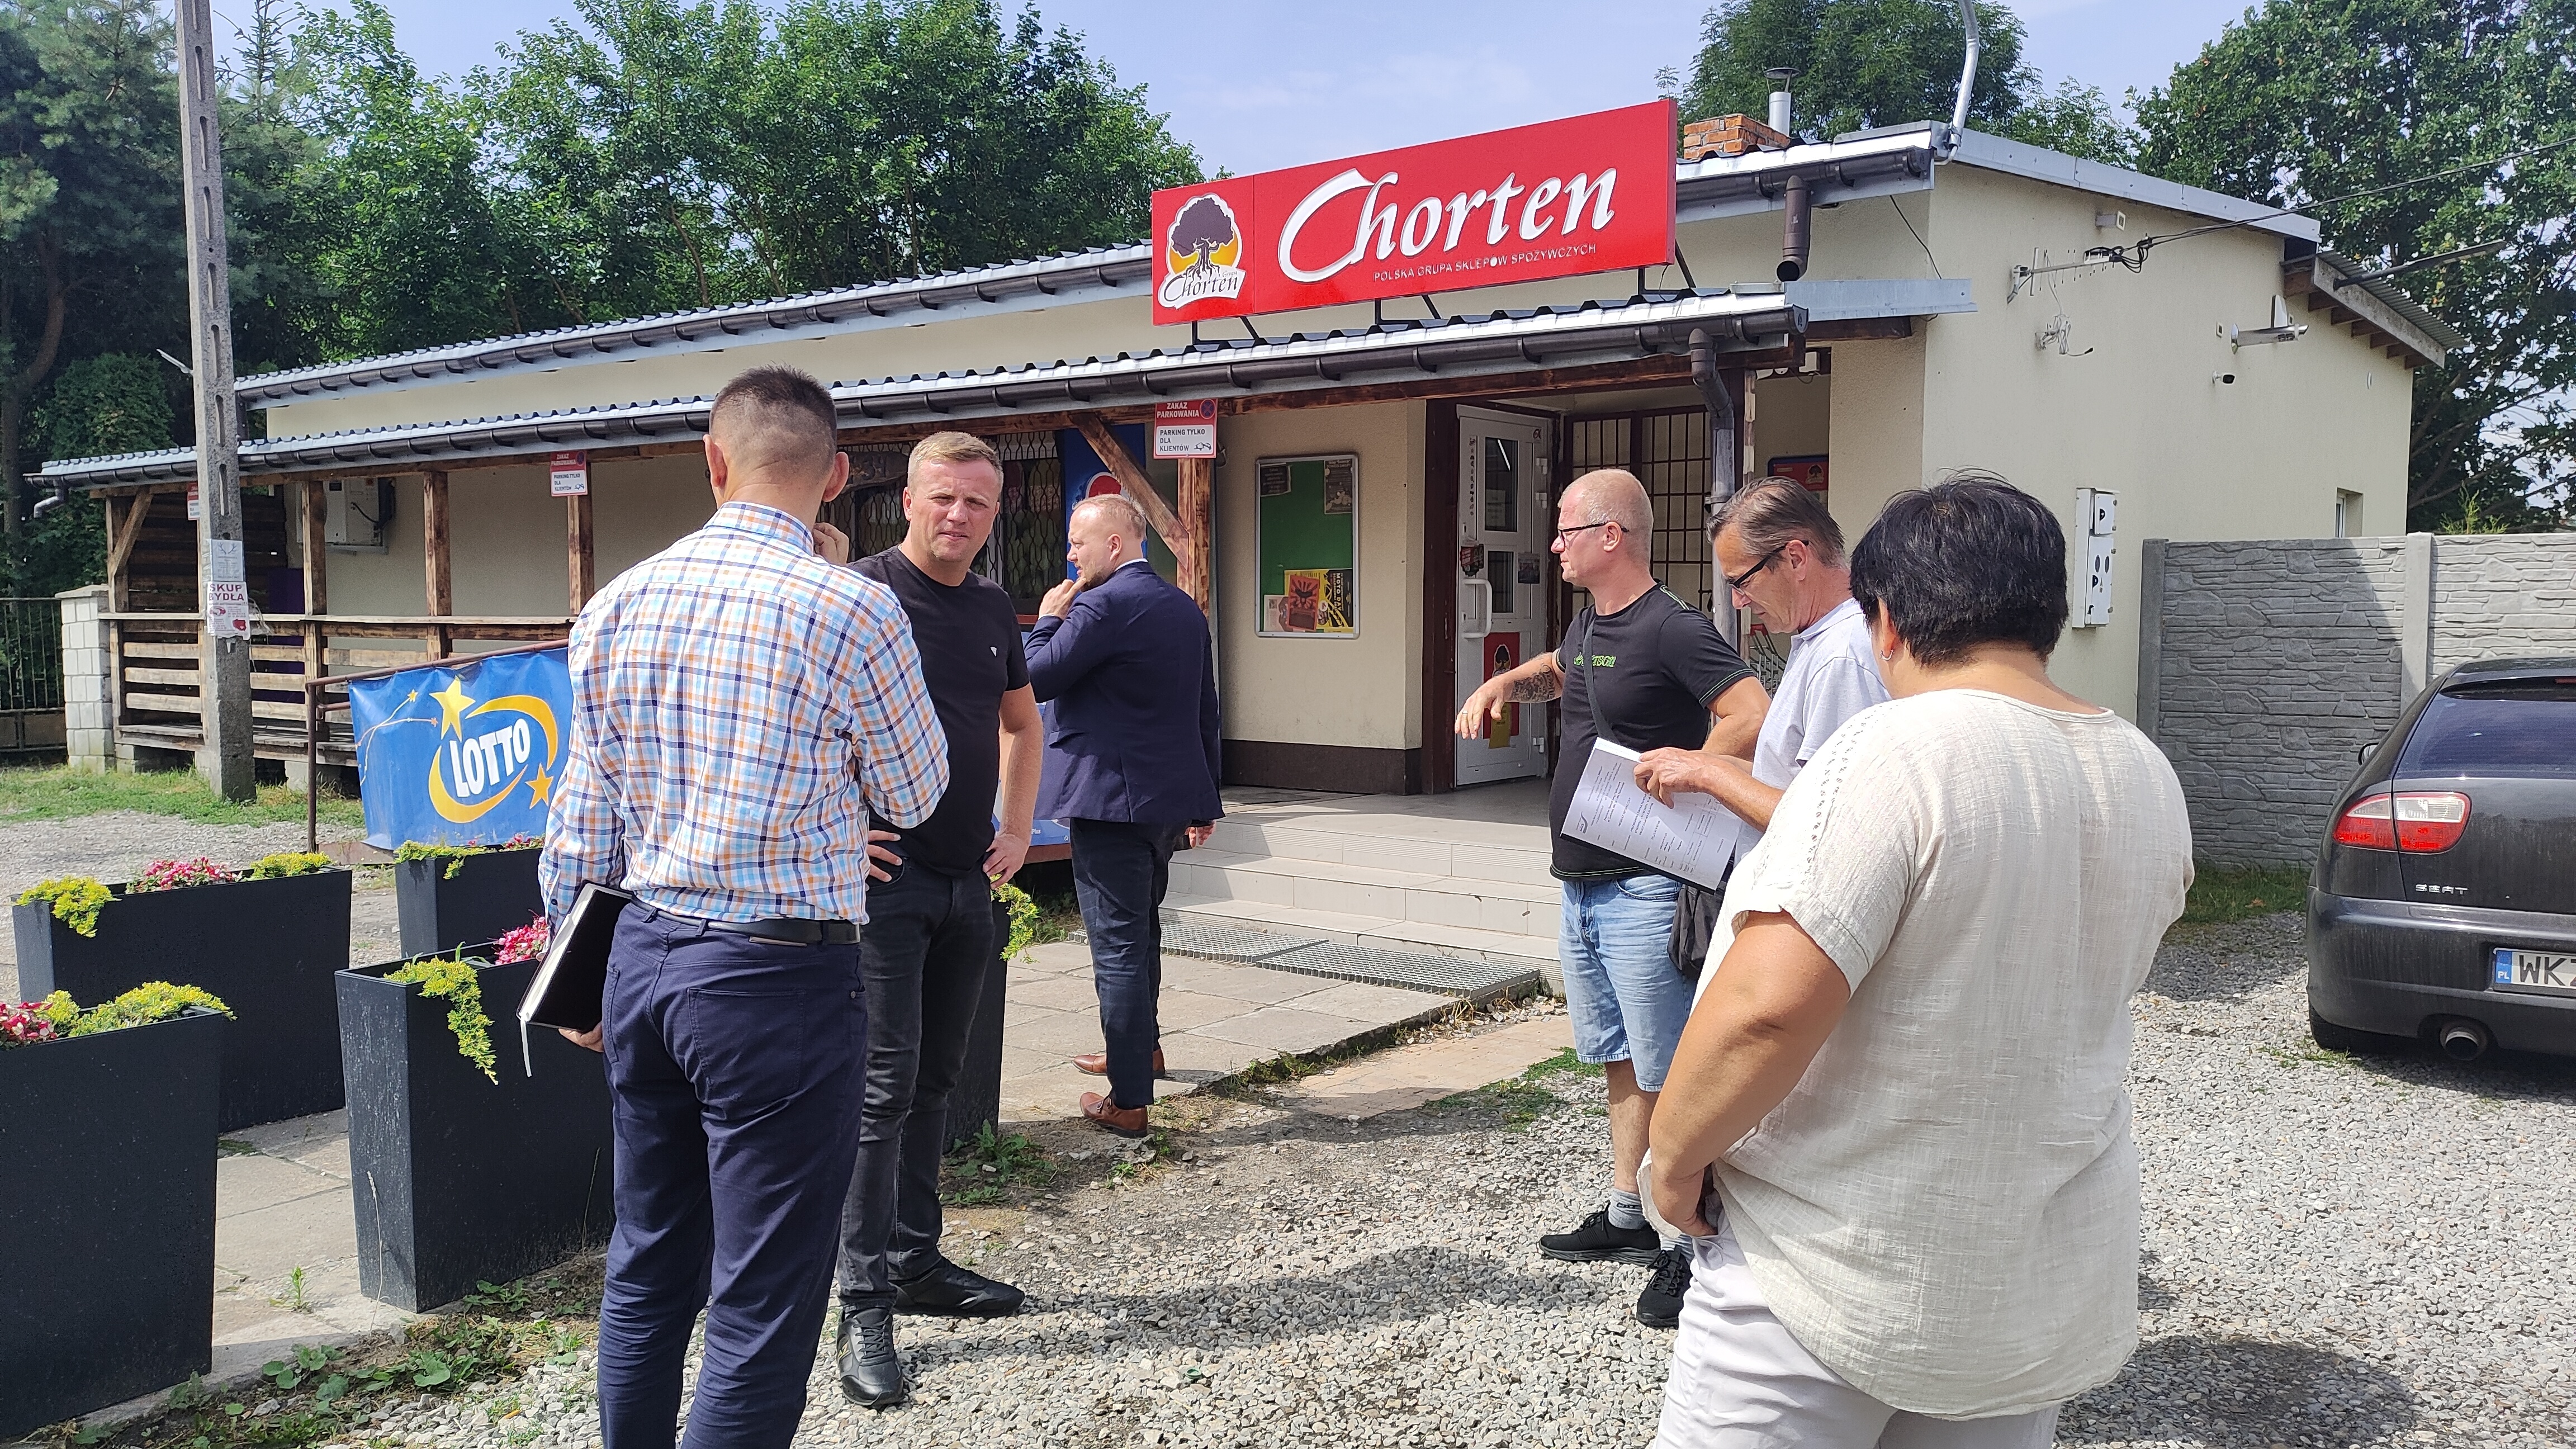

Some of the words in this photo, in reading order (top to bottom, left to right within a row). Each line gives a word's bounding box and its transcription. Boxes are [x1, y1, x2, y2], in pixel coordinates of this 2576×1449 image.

[1278, 168, 1616, 283] Chorten
[1374, 267, 1414, 282] POLSKA
[1417, 262, 1452, 277] GRUPA
[1455, 253, 1508, 272] SKLEPÓW
[1511, 243, 1597, 264] SPOŻYWCZYCH
[1164, 274, 1238, 301] Chorten
[1157, 410, 1200, 418] PARKOWANIA
[449, 718, 531, 797] LOTTO
[2416, 884, 2468, 895] SEAT
[2498, 970, 2509, 979] PL
